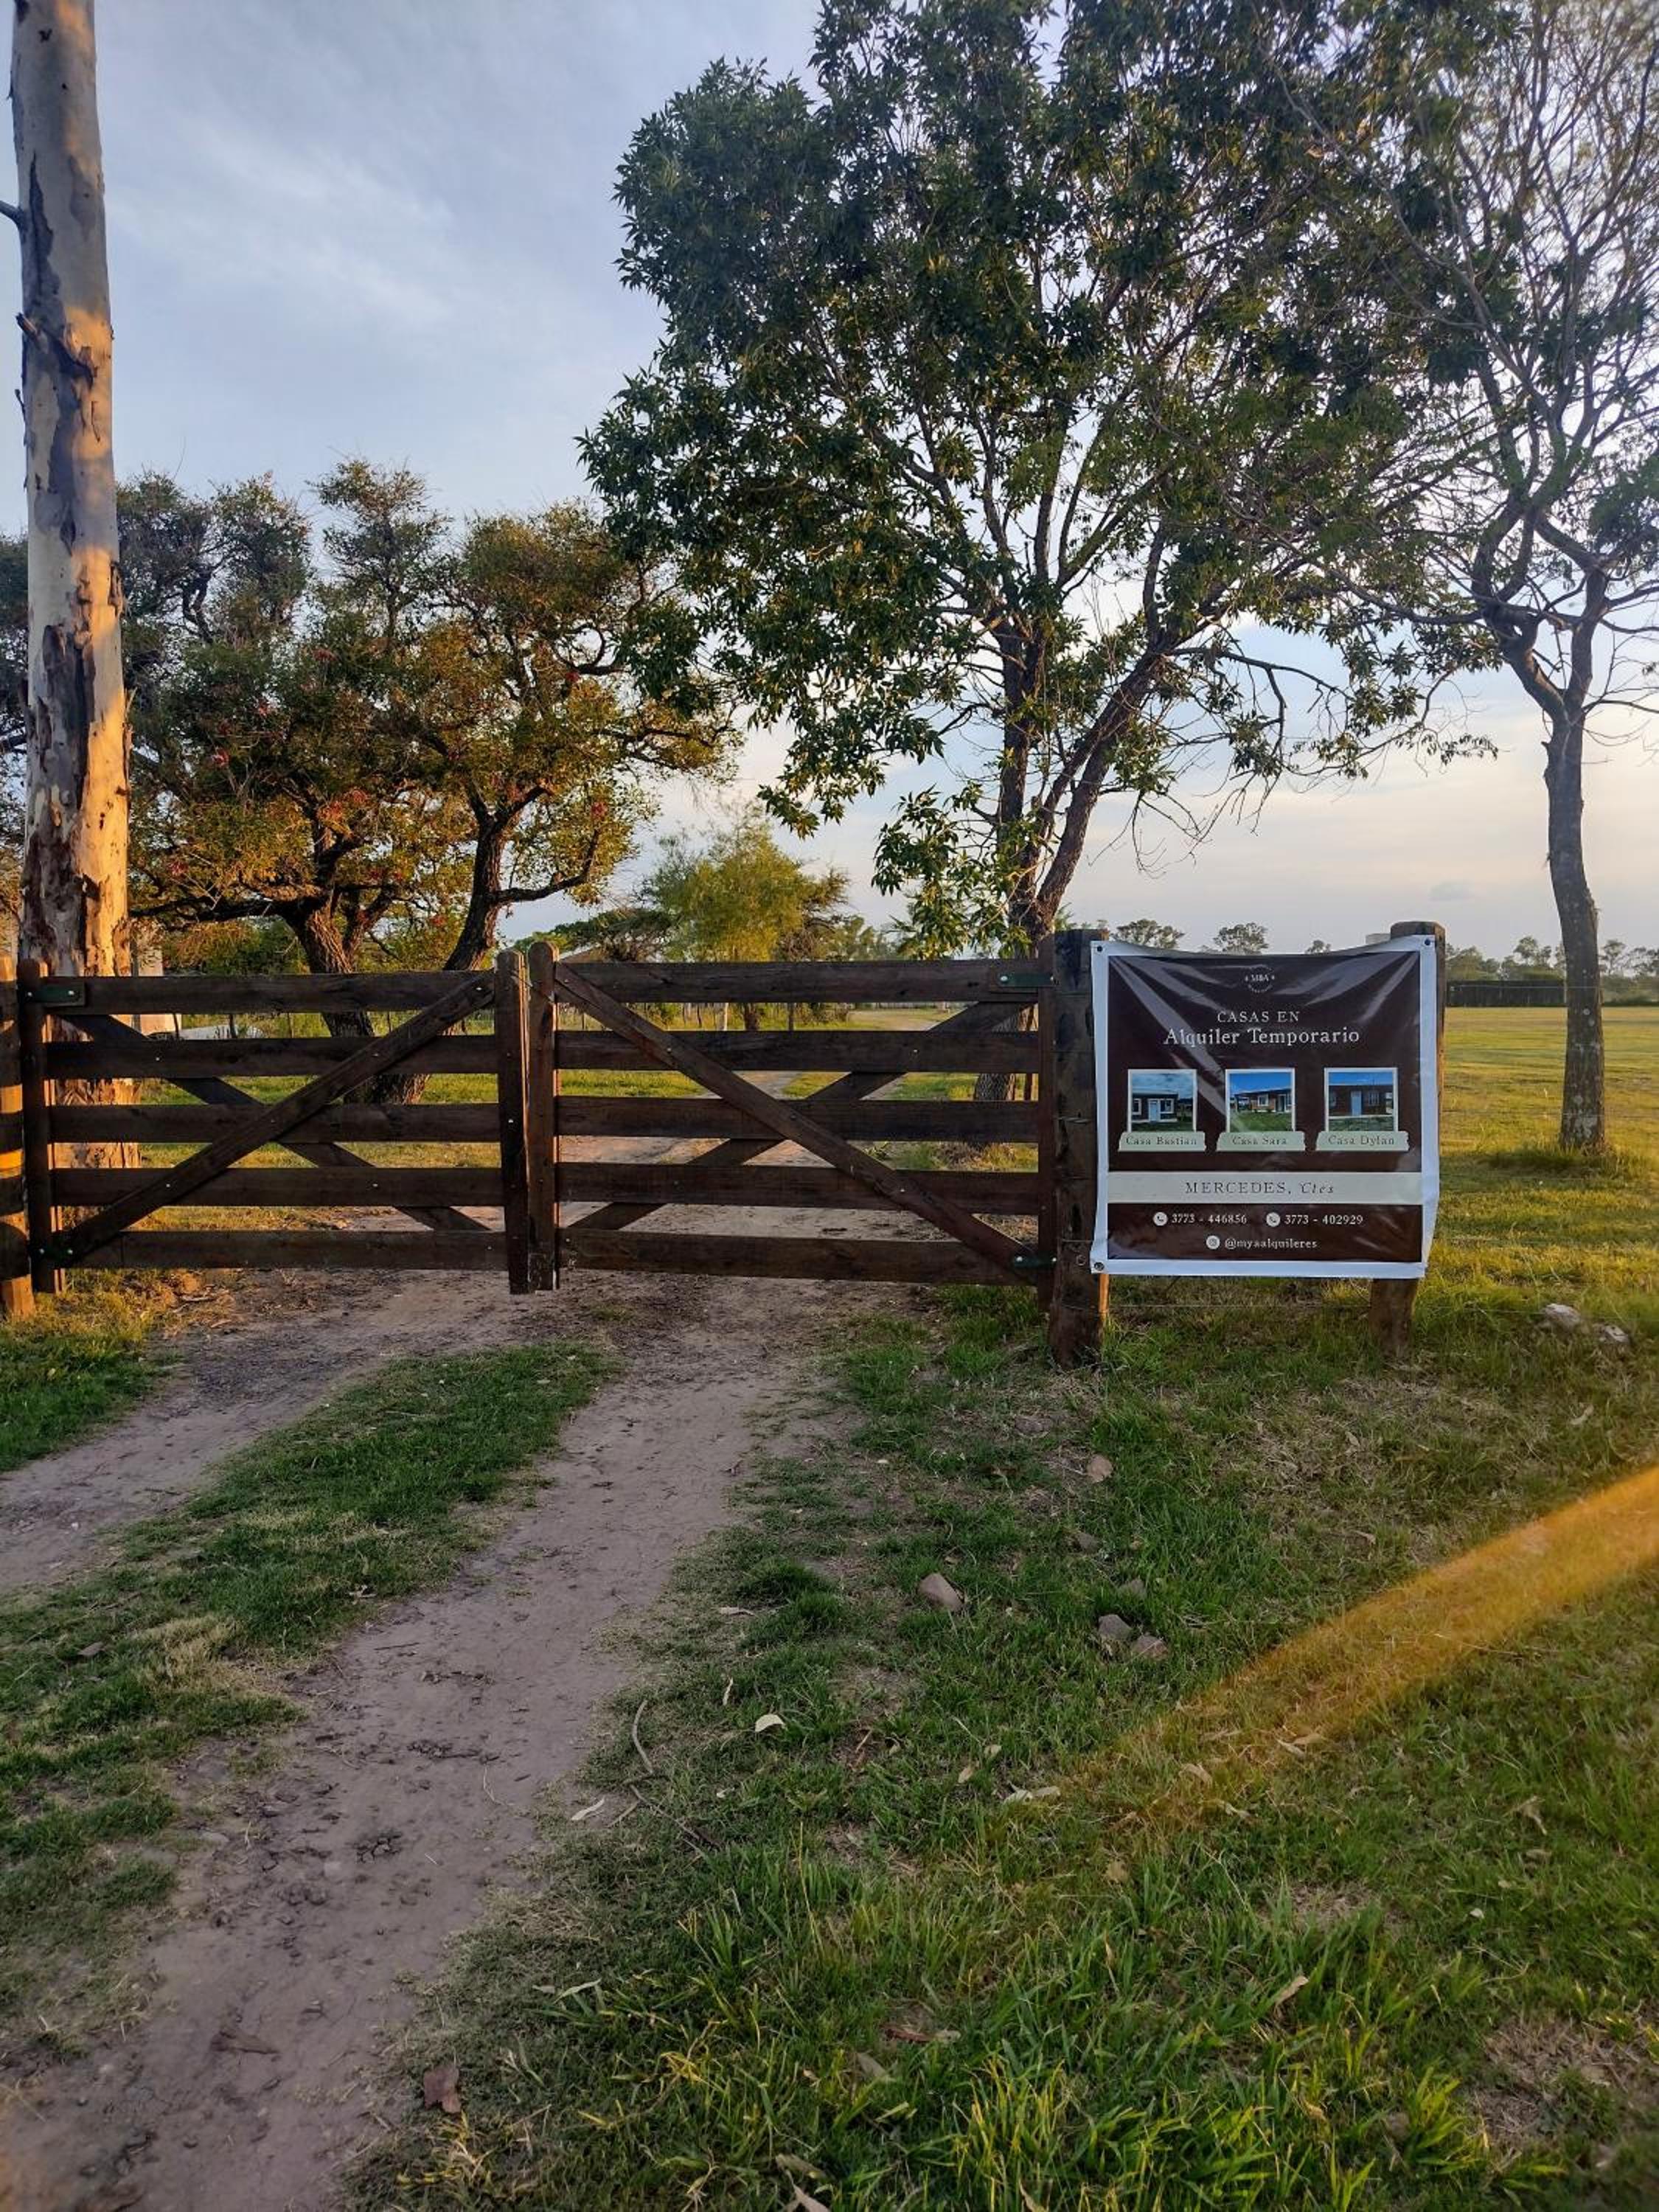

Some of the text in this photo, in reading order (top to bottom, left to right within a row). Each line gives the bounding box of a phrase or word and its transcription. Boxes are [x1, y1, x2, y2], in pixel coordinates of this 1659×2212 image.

[1217, 1012, 1300, 1023] CASAS EN
[1164, 1026, 1360, 1048] Alquiler Temporario
[1126, 1136, 1197, 1145] Casa Bastian
[1232, 1135, 1287, 1145] Casa Sara
[1328, 1135, 1394, 1146] Casa Dylan
[1184, 1182, 1292, 1194] MERCEDES,
[1171, 1214, 1195, 1224] 3773
[1284, 1214, 1309, 1225] 3773
[1322, 1214, 1363, 1225] 402929
